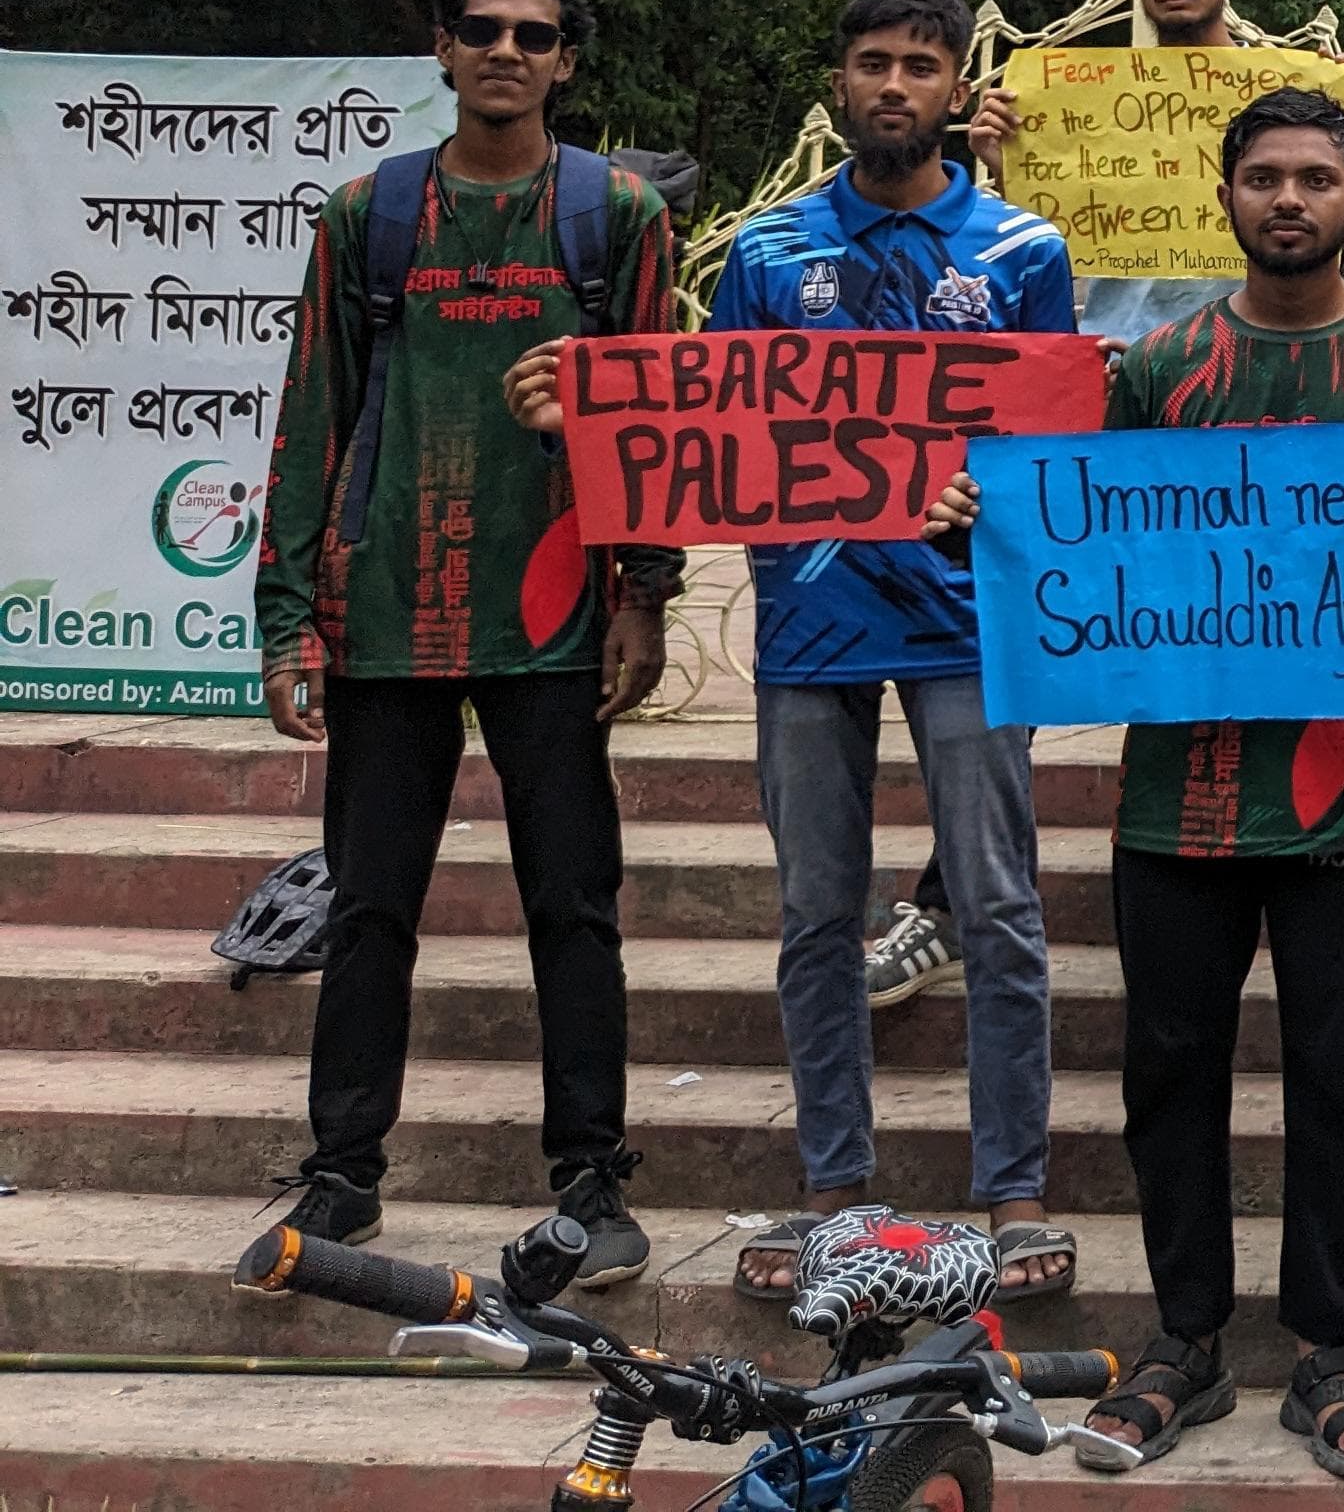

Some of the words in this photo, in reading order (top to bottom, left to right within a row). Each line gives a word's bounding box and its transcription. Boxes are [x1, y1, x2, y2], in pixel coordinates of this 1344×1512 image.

[1042, 52, 1116, 91] Fear
[1130, 52, 1169, 85] the
[55, 82, 282, 161] শহীদদের
[294, 87, 402, 163] প্রতি
[1060, 106, 1102, 137] the
[1018, 152, 1073, 183] for
[1077, 144, 1147, 183] there
[80, 191, 227, 250] সম্মান
[1026, 188, 1189, 246] Between
[2, 270, 134, 350] শহীদ
[575, 332, 1021, 424] LIBARATE
[11, 378, 116, 451] খুলে
[128, 382, 273, 441] প্রবেশ
[177, 493, 227, 511] Campus
[183, 480, 225, 495] Clean
[1031, 442, 1270, 546] Ummah
[0, 596, 153, 649] Clean
[175, 600, 263, 651] Ca
[1034, 548, 1304, 658] Salauddin
[122, 681, 162, 708] by:
[169, 680, 236, 705] Azim
[591, 1337, 656, 1397] DUANTA
[804, 1392, 889, 1422] DURANTA
